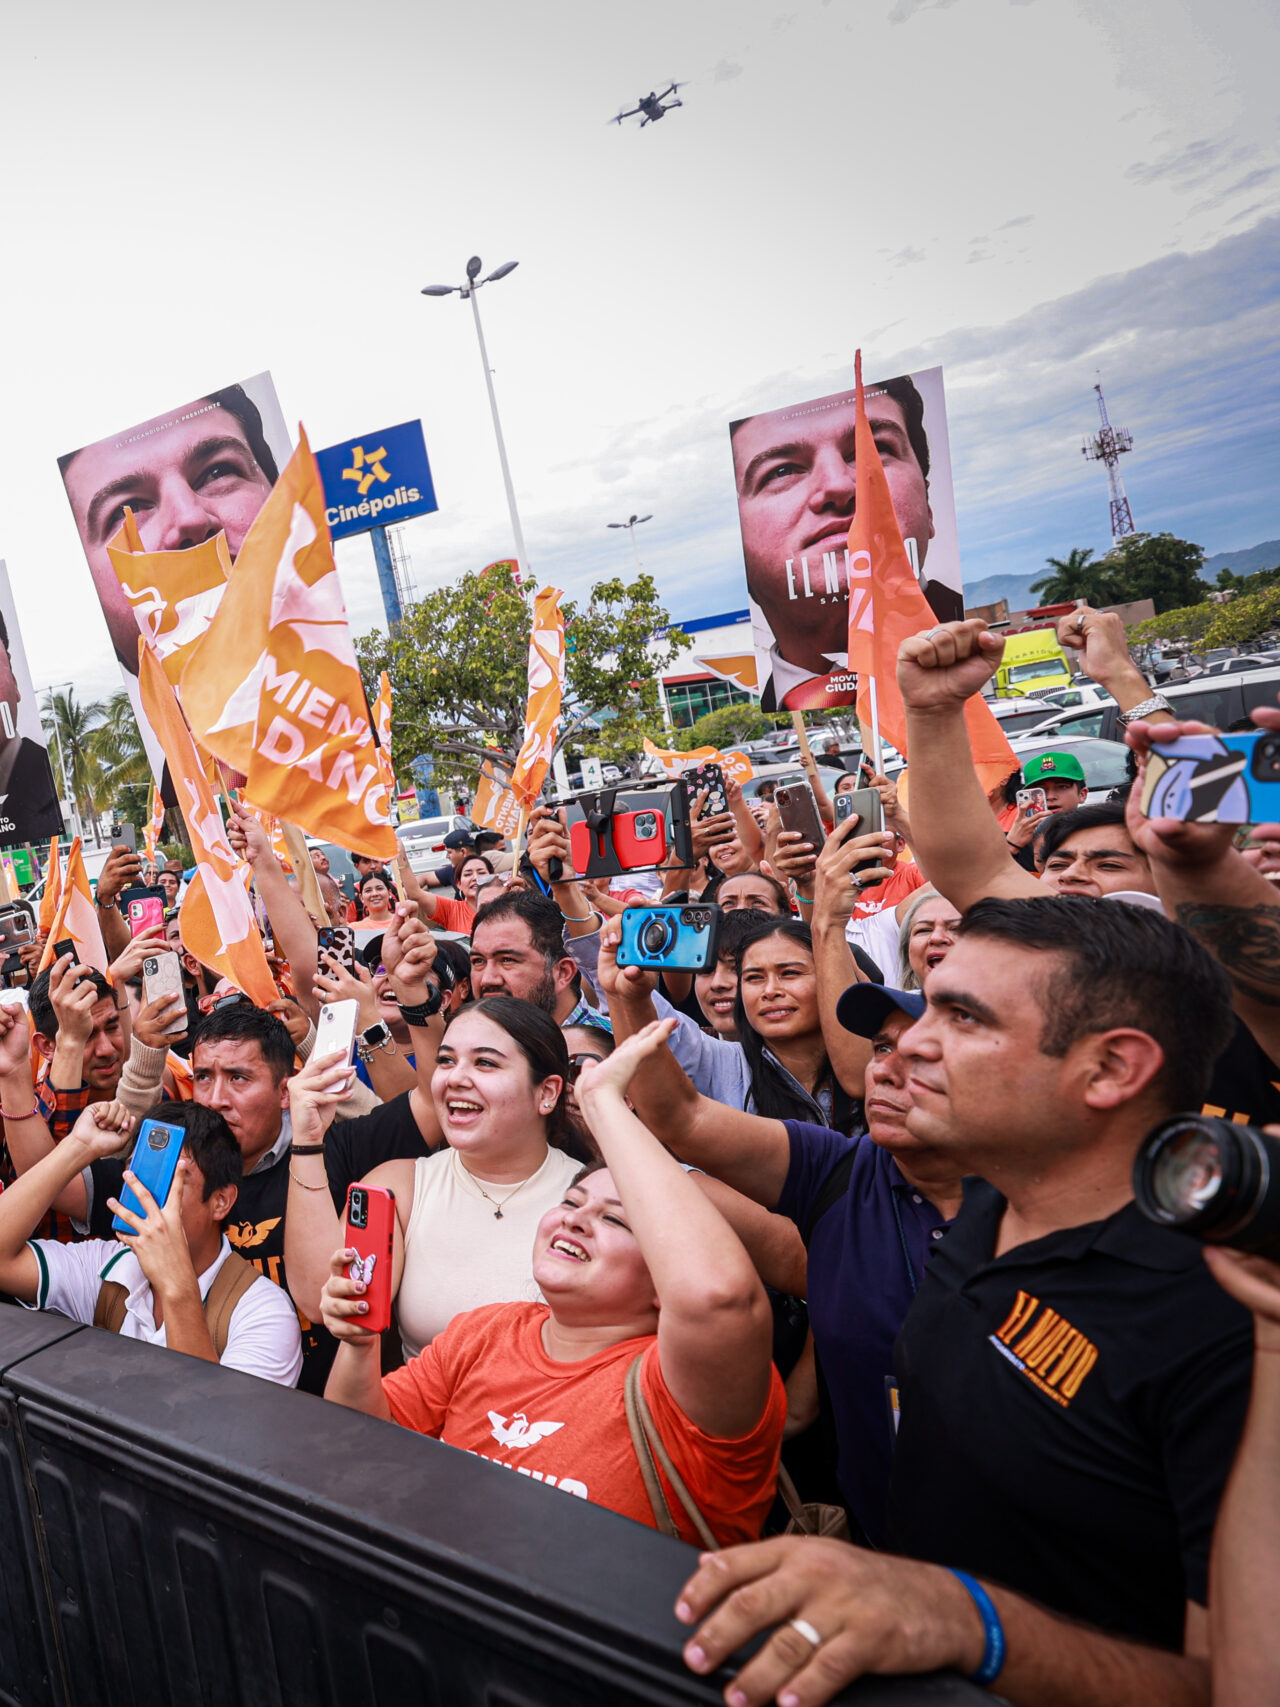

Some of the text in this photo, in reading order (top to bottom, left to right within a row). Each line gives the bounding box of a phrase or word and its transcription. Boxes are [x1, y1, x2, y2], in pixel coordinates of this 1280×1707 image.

[181, 401, 221, 421] PRESIDENTE
[325, 486, 421, 526] Cinépolis
[785, 556, 814, 600] EL
[588, 765, 595, 774] 4
[995, 1289, 1099, 1399] EL NUEVO
